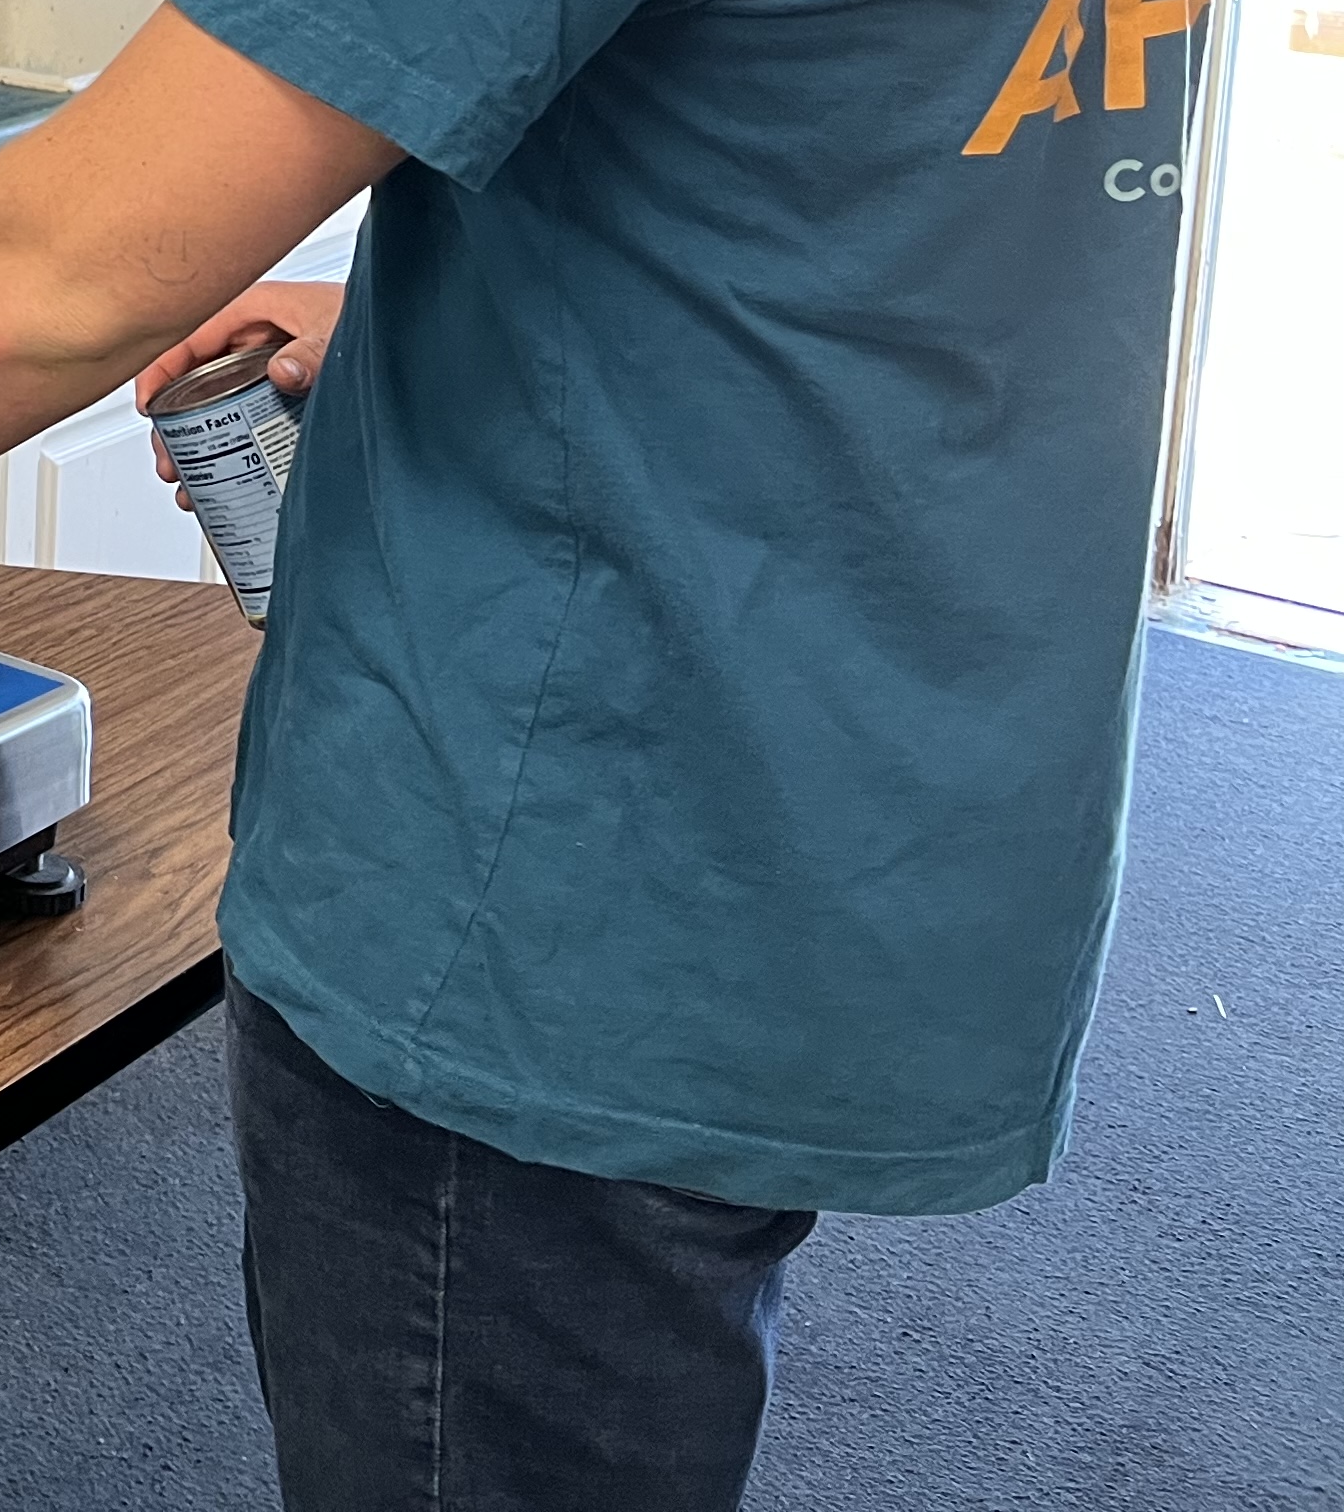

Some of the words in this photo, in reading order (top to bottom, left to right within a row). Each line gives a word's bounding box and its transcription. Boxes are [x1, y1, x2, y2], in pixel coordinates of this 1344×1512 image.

[1103, 157, 1182, 203] Co
[205, 411, 242, 431] Facts
[242, 452, 261, 469] 70
